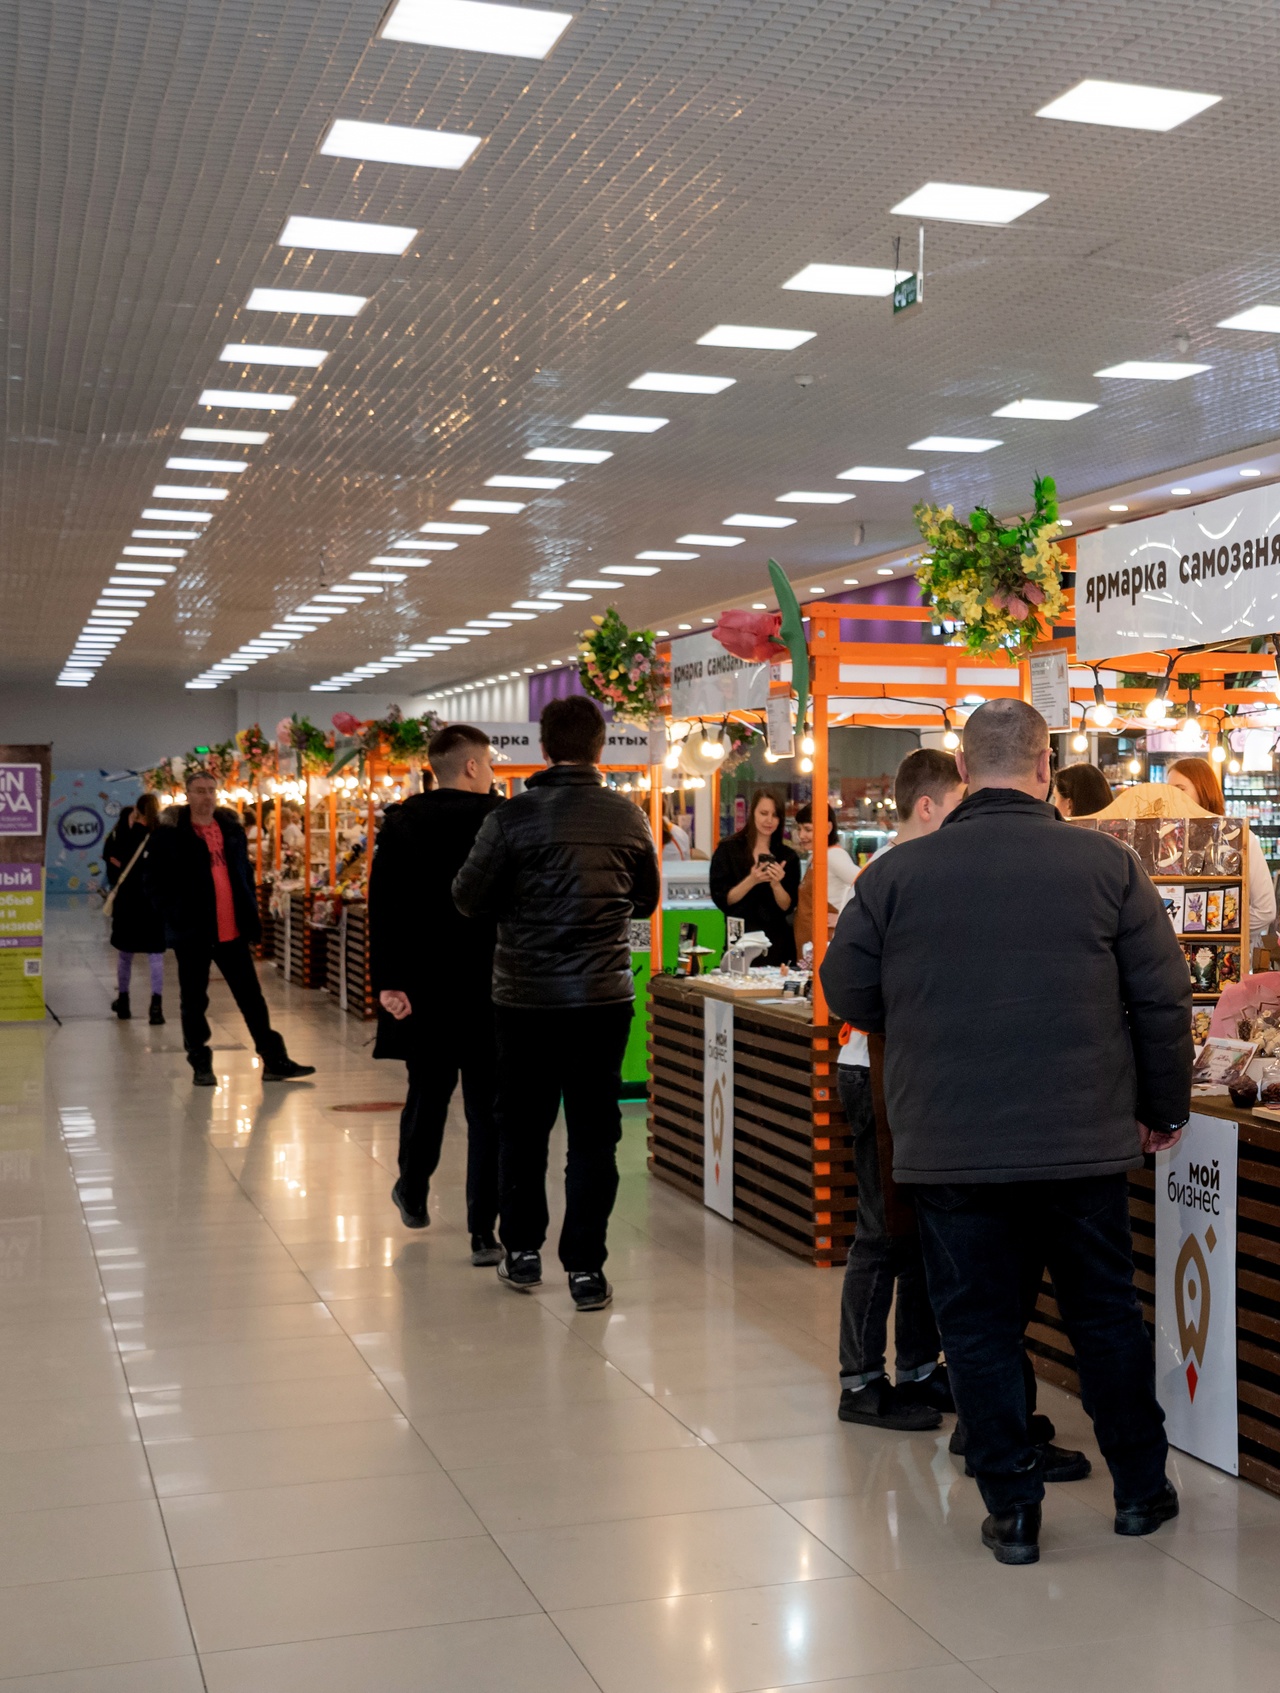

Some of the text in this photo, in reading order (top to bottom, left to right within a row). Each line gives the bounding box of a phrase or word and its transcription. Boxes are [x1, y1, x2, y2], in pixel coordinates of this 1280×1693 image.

[1085, 560, 1167, 612] ярмарка
[489, 735, 648, 748] арка ятых
[0, 868, 32, 886] ый
[1189, 1159, 1220, 1190] мой
[1167, 1172, 1220, 1215] бизнес
